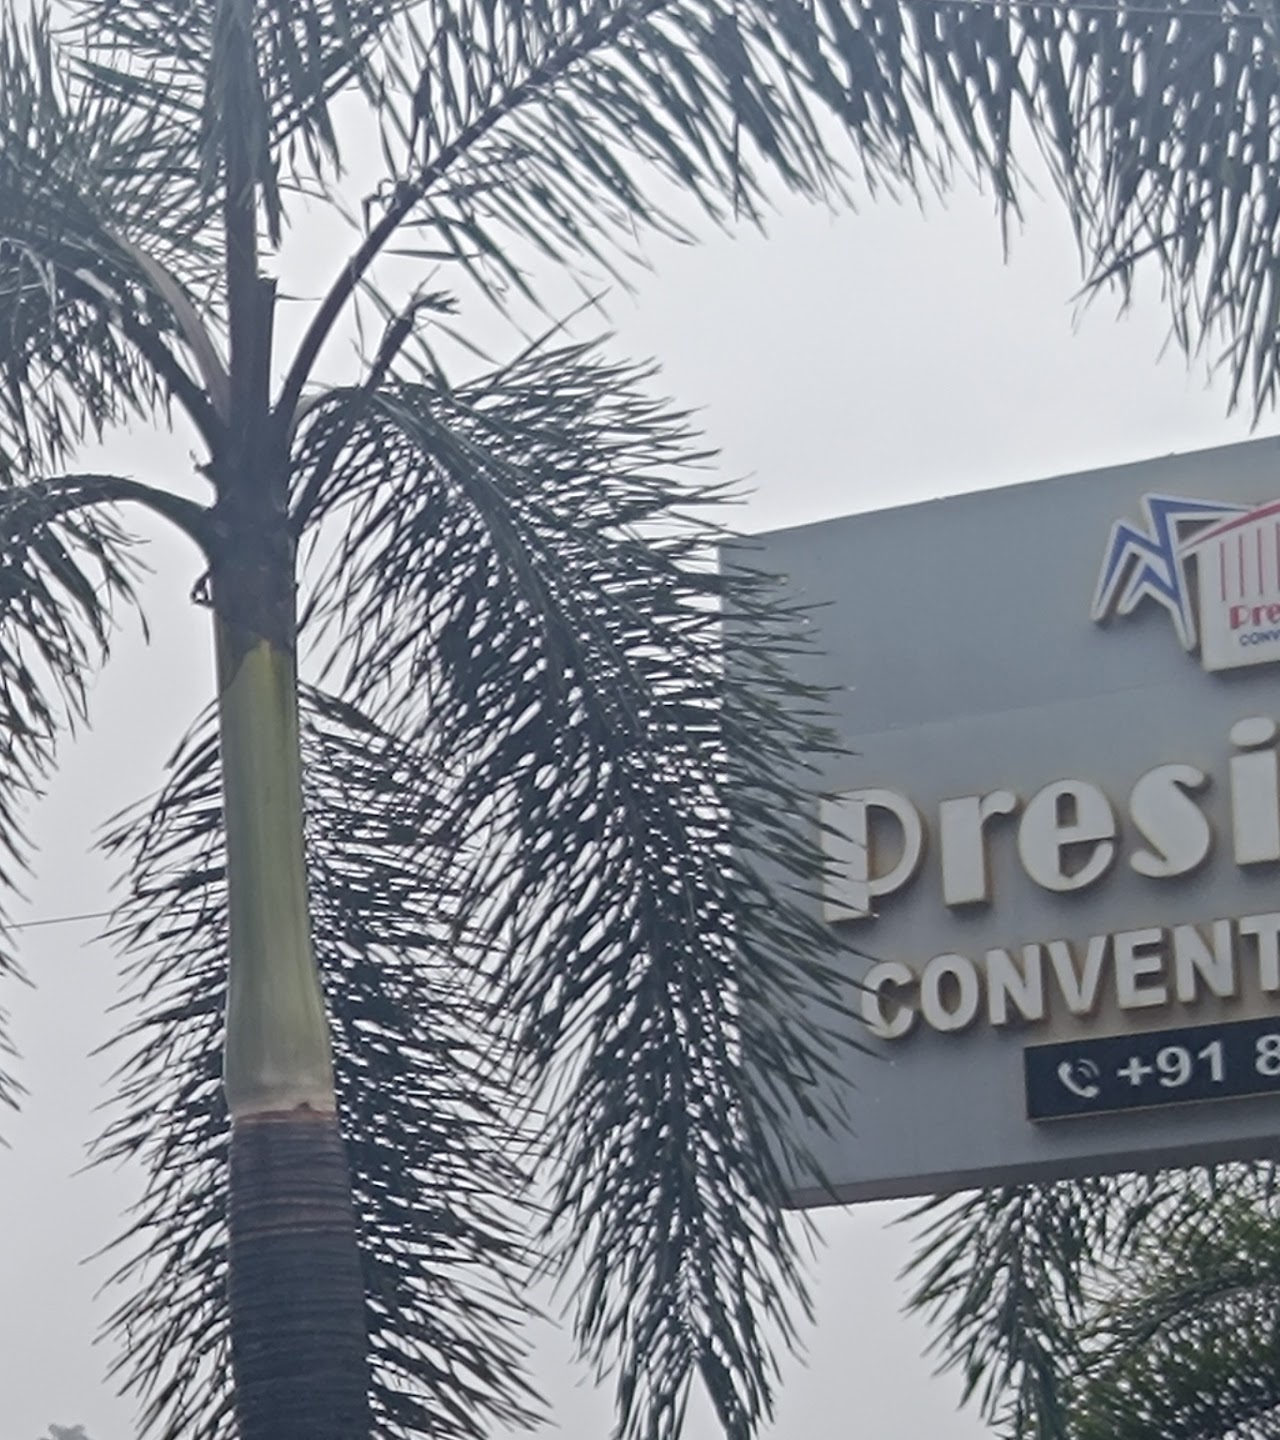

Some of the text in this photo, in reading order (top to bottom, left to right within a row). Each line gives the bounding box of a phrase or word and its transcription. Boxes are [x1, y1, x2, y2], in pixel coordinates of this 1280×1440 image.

[817, 716, 1280, 923] Presi
[860, 912, 1280, 1040] CONVENT
[1117, 1040, 1224, 1087] +91
